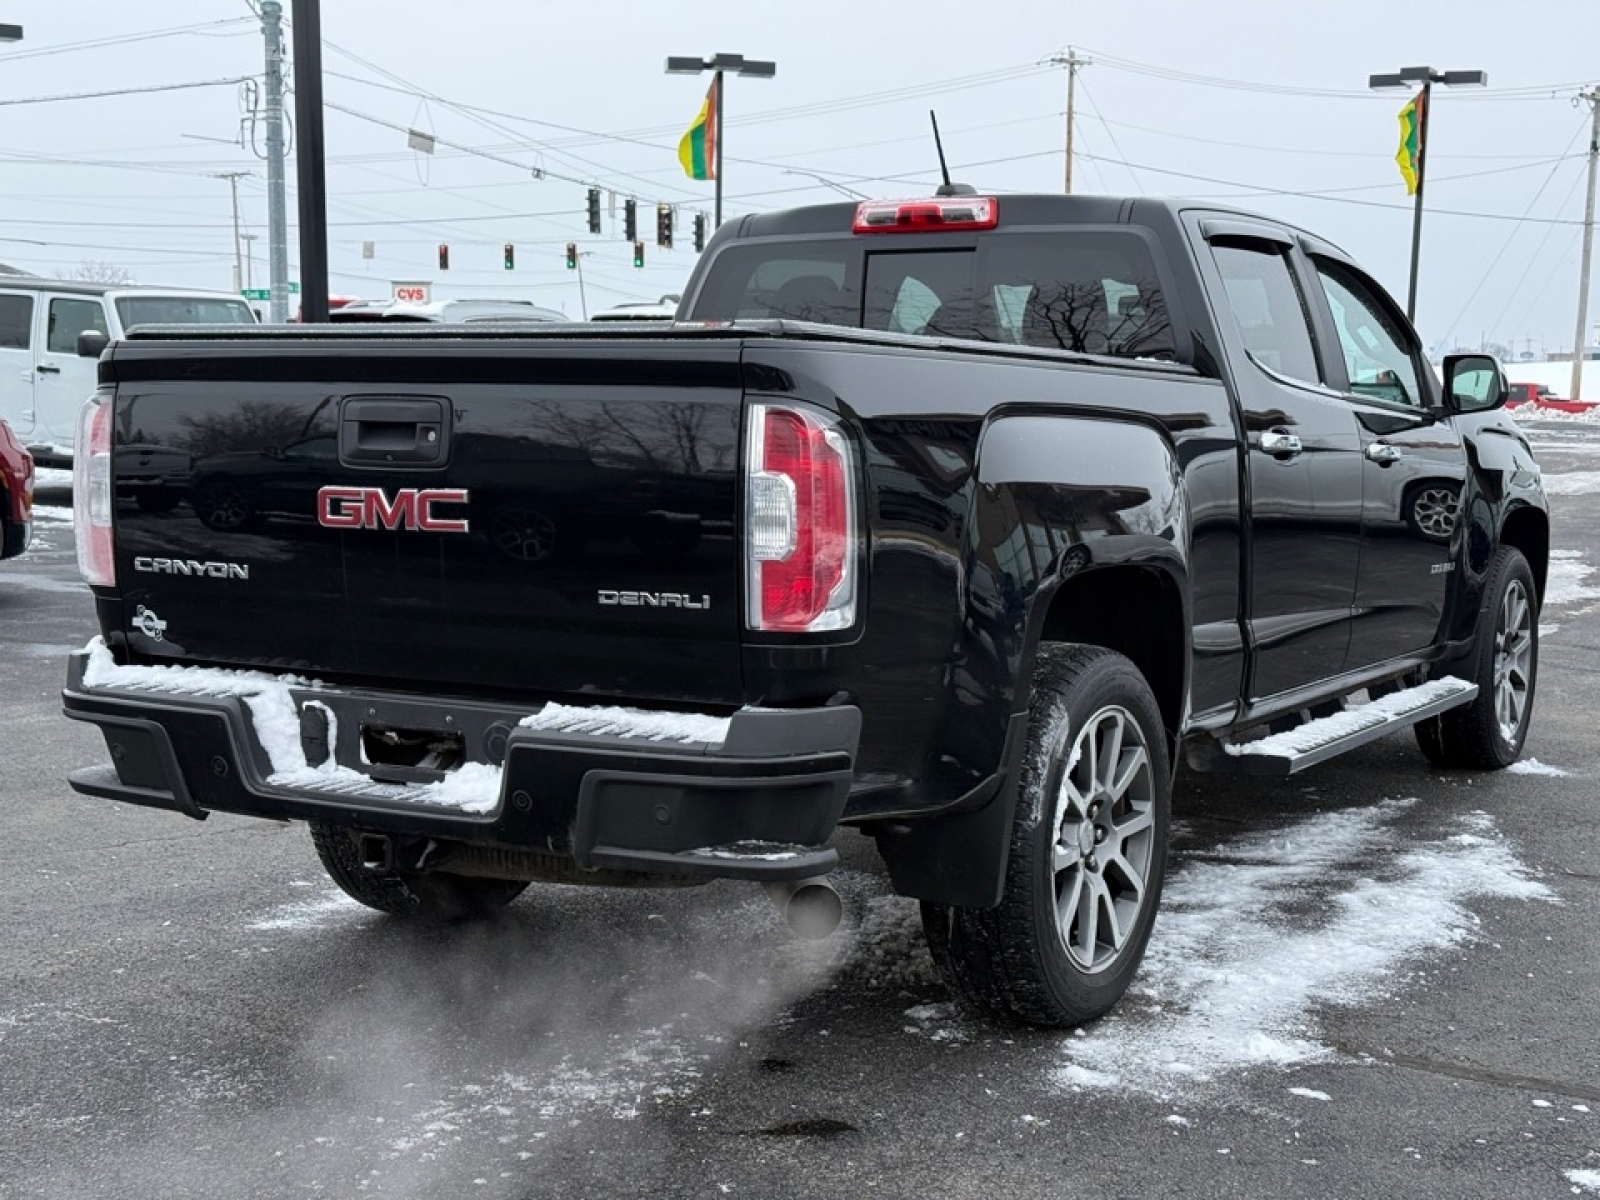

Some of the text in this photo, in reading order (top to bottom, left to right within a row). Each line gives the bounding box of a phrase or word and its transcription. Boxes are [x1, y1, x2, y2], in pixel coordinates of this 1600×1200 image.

[397, 287, 424, 301] CVS
[317, 485, 469, 533] GMC
[134, 556, 249, 580] CANYON
[597, 589, 711, 609] DENALI
